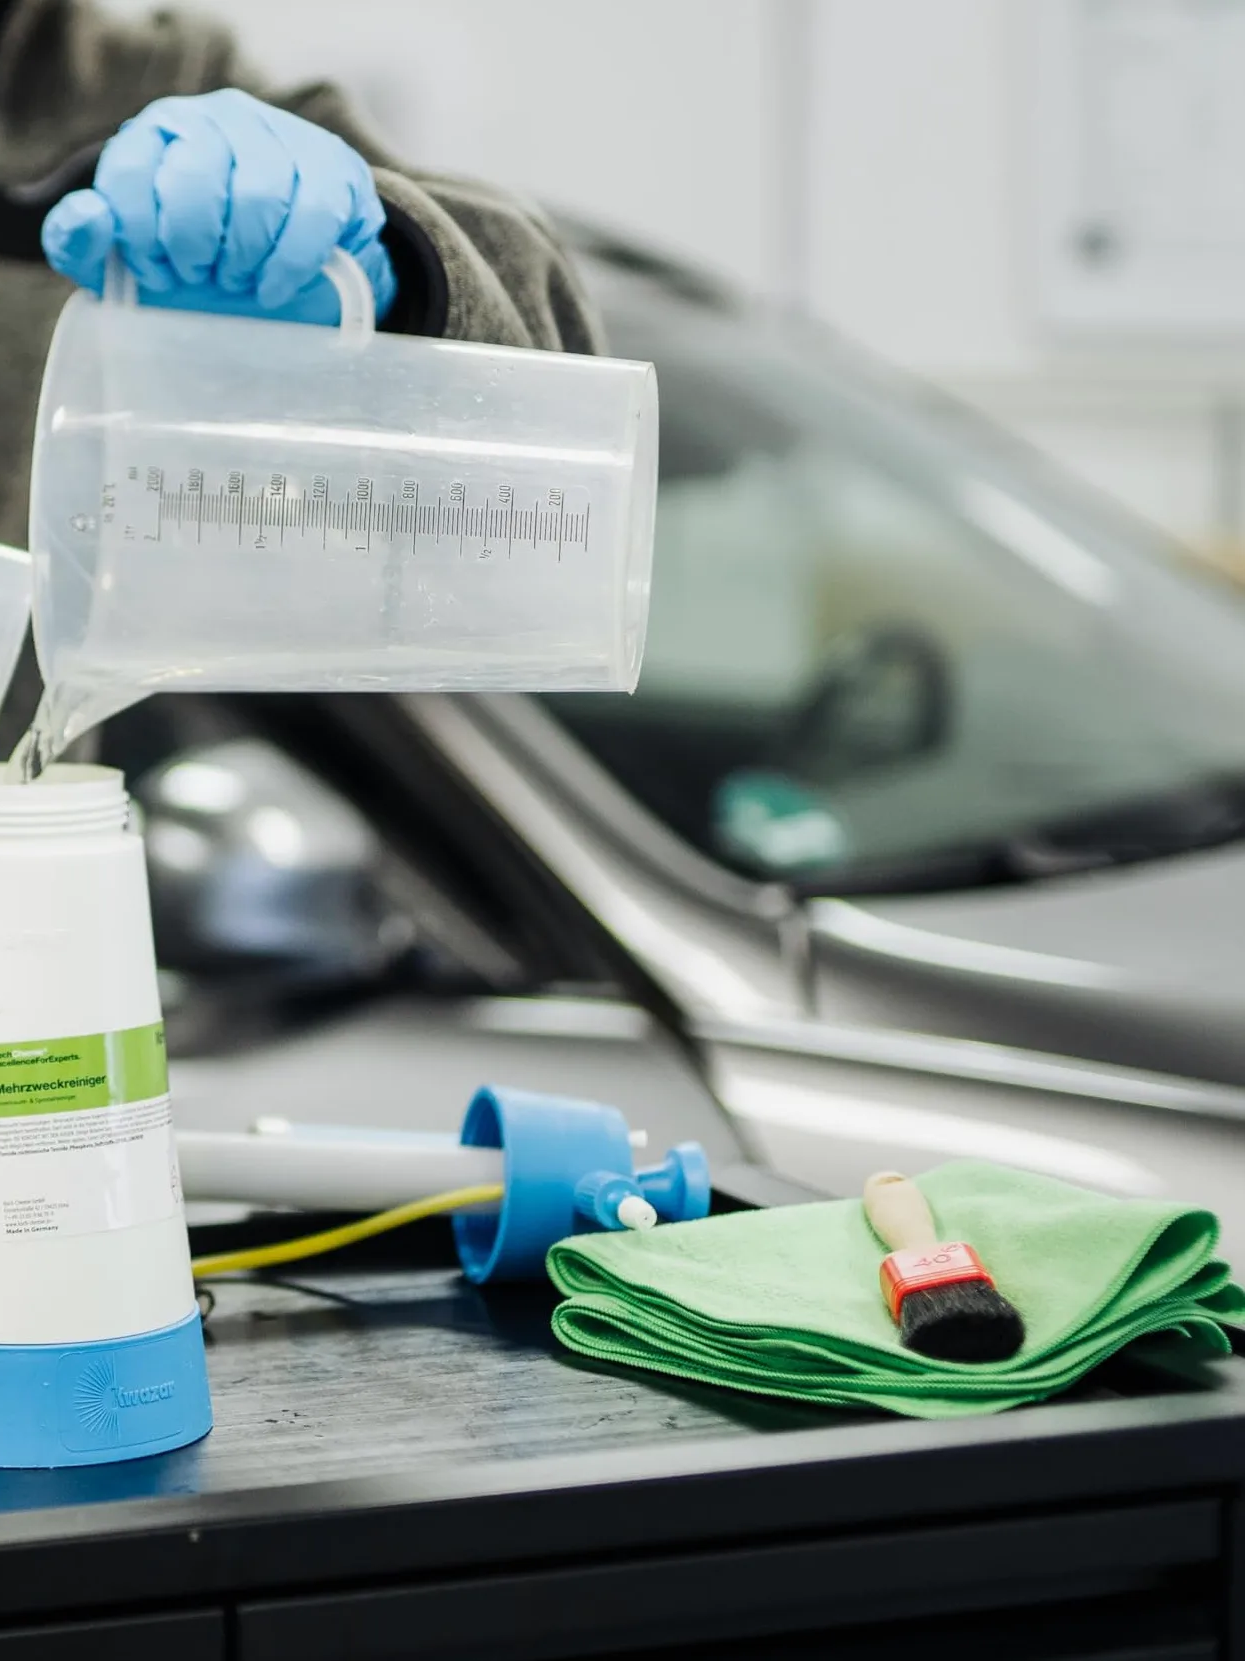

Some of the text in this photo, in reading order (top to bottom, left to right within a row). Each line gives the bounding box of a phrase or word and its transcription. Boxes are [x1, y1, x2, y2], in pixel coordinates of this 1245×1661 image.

[146, 466, 161, 492] 2000
[187, 468, 201, 492] 1800
[228, 471, 241, 495] 1600
[270, 473, 283, 497] 1400
[313, 475, 326, 500] 1200
[357, 477, 370, 501] 1000
[402, 480, 416, 499] 800
[450, 482, 463, 502] 600
[498, 485, 512, 504] 400
[548, 488, 562, 506] 200
[31, 1225, 59, 1234] Germany
